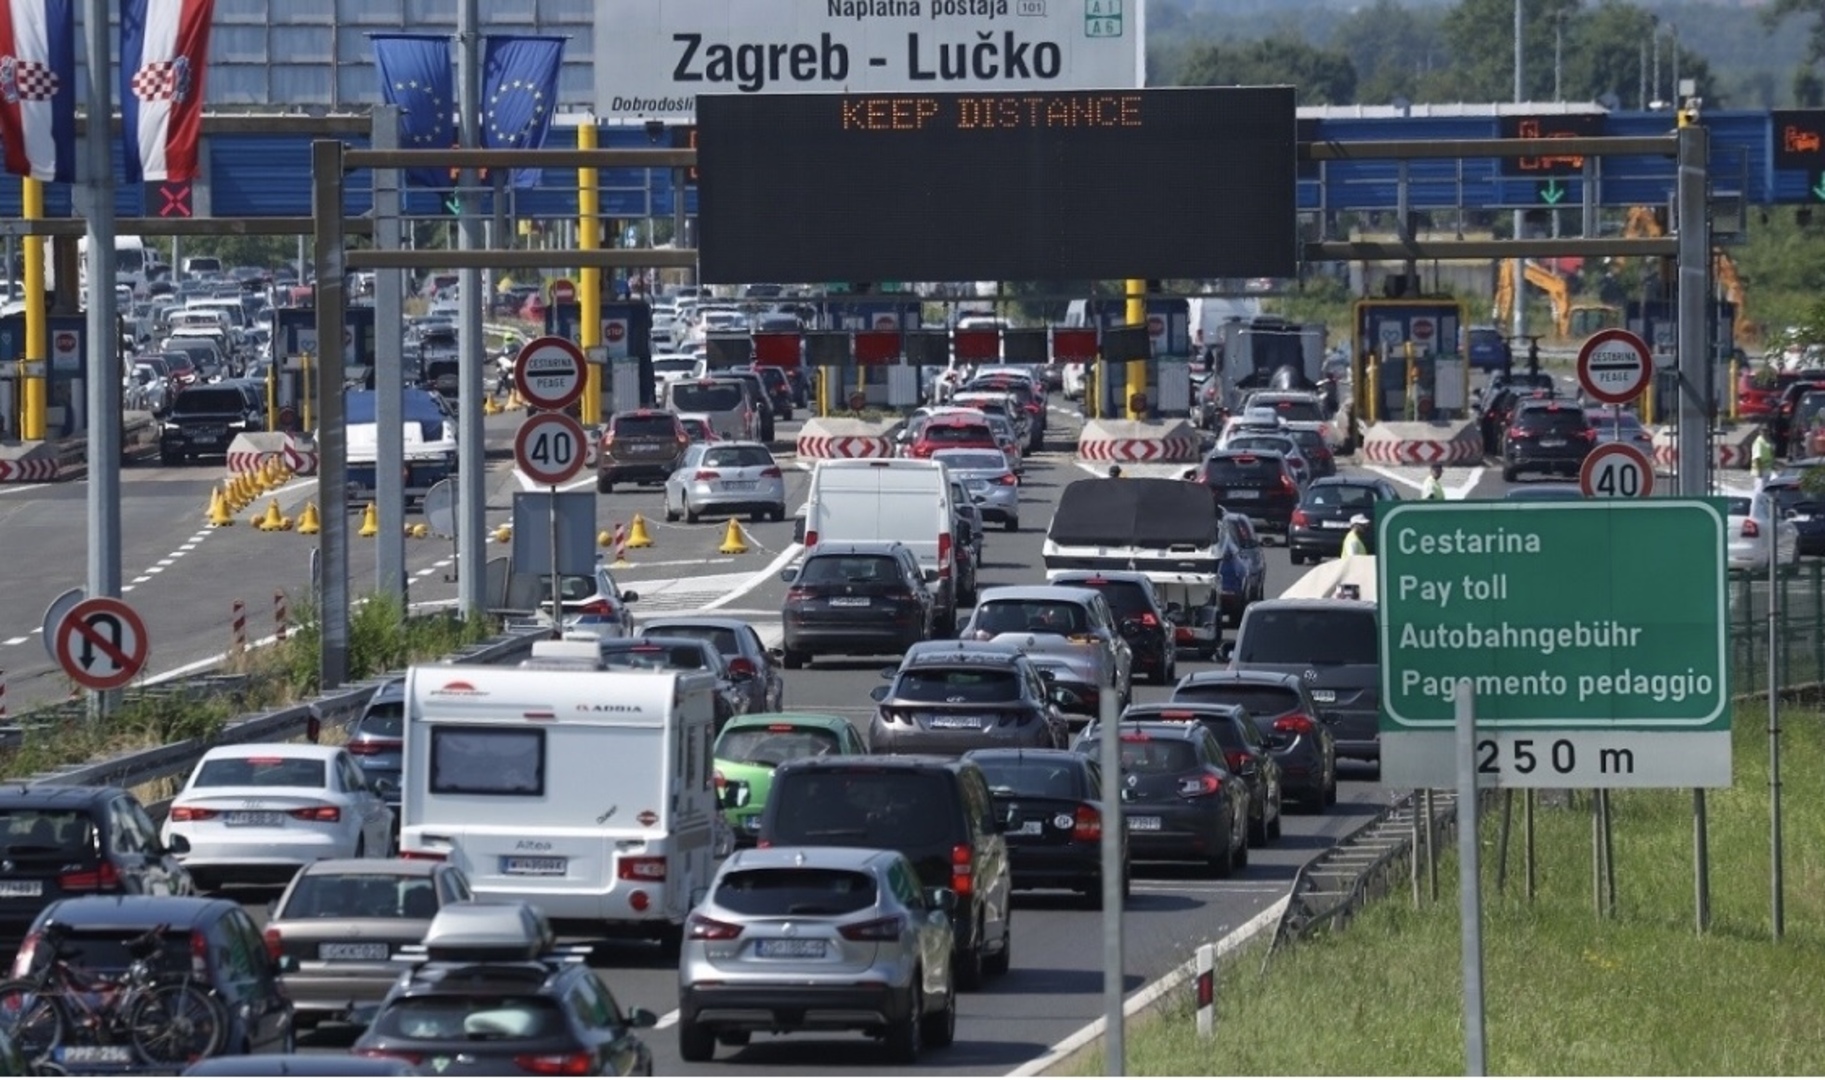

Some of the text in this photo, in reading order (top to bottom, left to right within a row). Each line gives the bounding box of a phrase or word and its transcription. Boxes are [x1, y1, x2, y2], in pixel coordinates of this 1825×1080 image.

[828, 0, 1007, 20] Naplatna postaja
[1022, 3, 1042, 12] 101
[672, 31, 1061, 92] Zagreb - Lučko
[611, 96, 694, 112] Dobrodošli
[842, 96, 1142, 130] KEEP DISTANCE
[529, 358, 572, 369] CESTARINA
[1592, 351, 1637, 362] CESTARINA
[536, 376, 566, 388] PEAGE
[531, 432, 571, 465] 40
[1597, 463, 1638, 497] 40
[1398, 527, 1540, 554] Cestarina
[1399, 573, 1506, 607] Pay toll
[1399, 621, 1642, 655] Autobahngebühr
[1578, 667, 1712, 702] pedaggio
[1599, 747, 1634, 774] m
